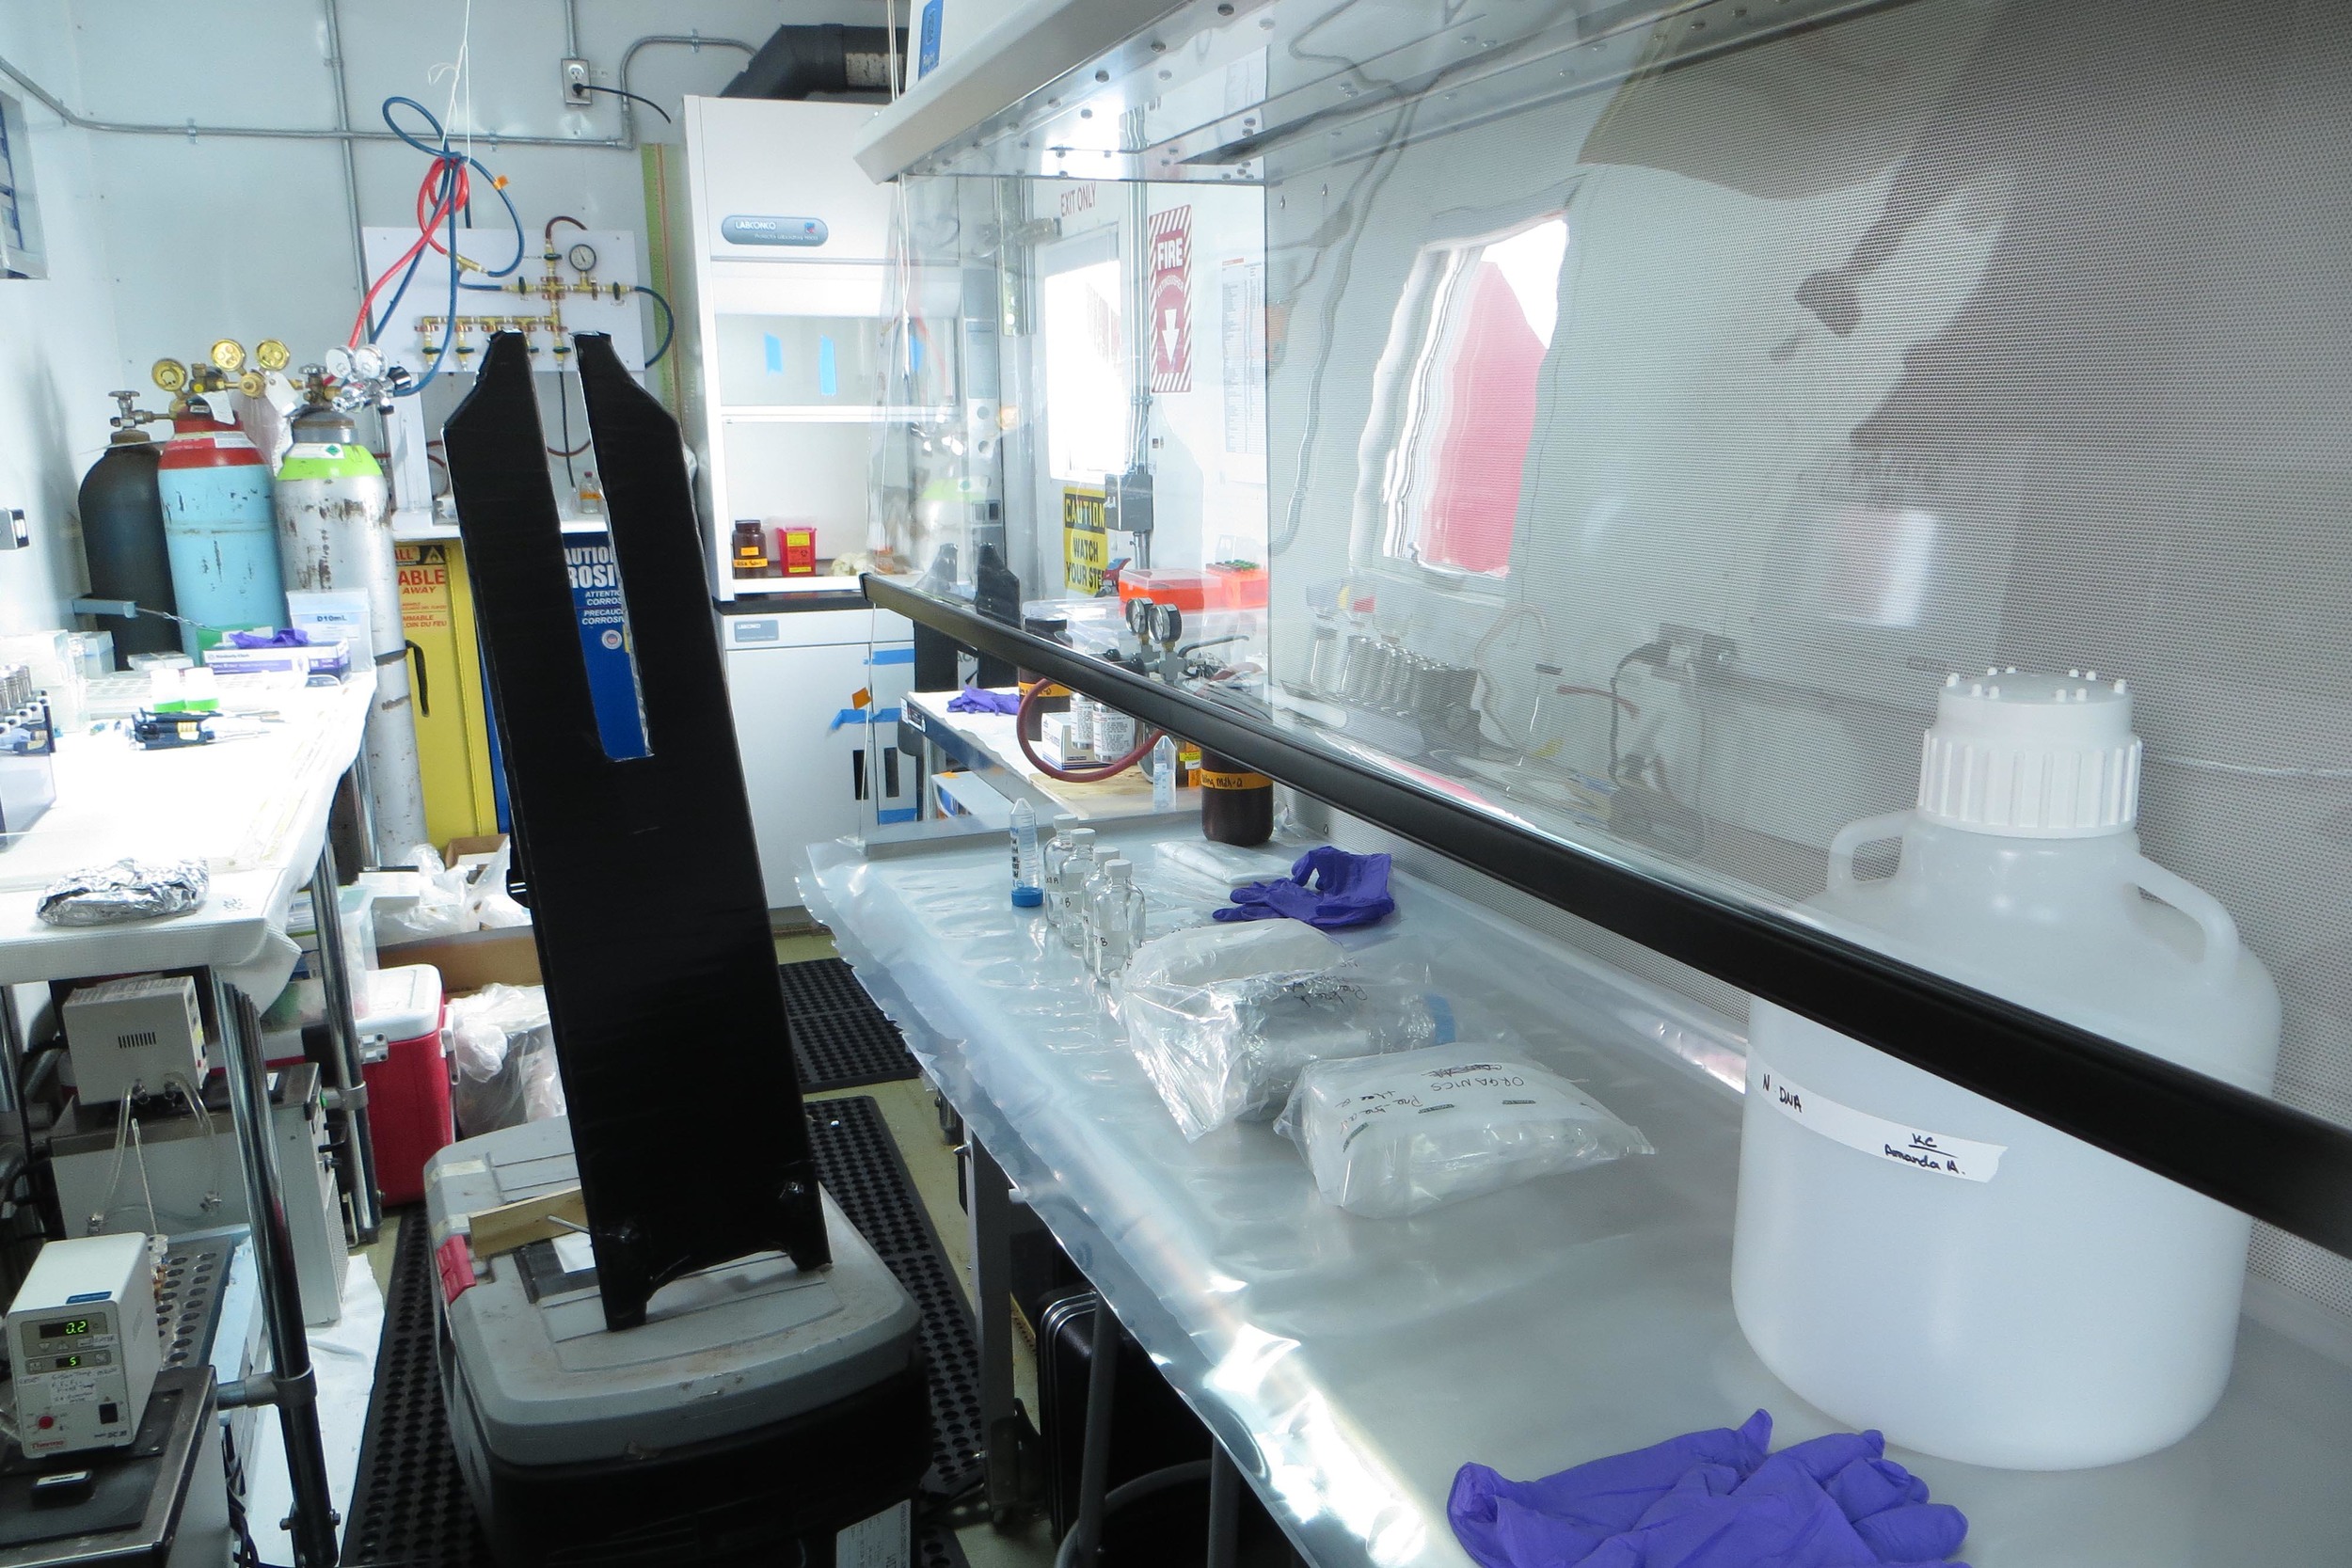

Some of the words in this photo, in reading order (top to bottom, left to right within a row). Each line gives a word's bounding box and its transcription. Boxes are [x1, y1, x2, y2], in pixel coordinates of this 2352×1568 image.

[1060, 189, 1076, 217] EXIT
[1076, 182, 1096, 212] ONLY
[735, 221, 776, 230] LABCONCO
[1157, 238, 1184, 271] FIRE
[1065, 498, 1105, 529] CAUTION
[1073, 537, 1099, 563] WATCH
[1066, 562, 1088, 586] YOUR
[403, 586, 436, 594] AWAY
[1430, 1076, 1524, 1092] ORGANICS
[1779, 1085, 1803, 1114] DNA
[1884, 1143, 1941, 1170] Amanda
[66, 1321, 87, 1335] 0.2
